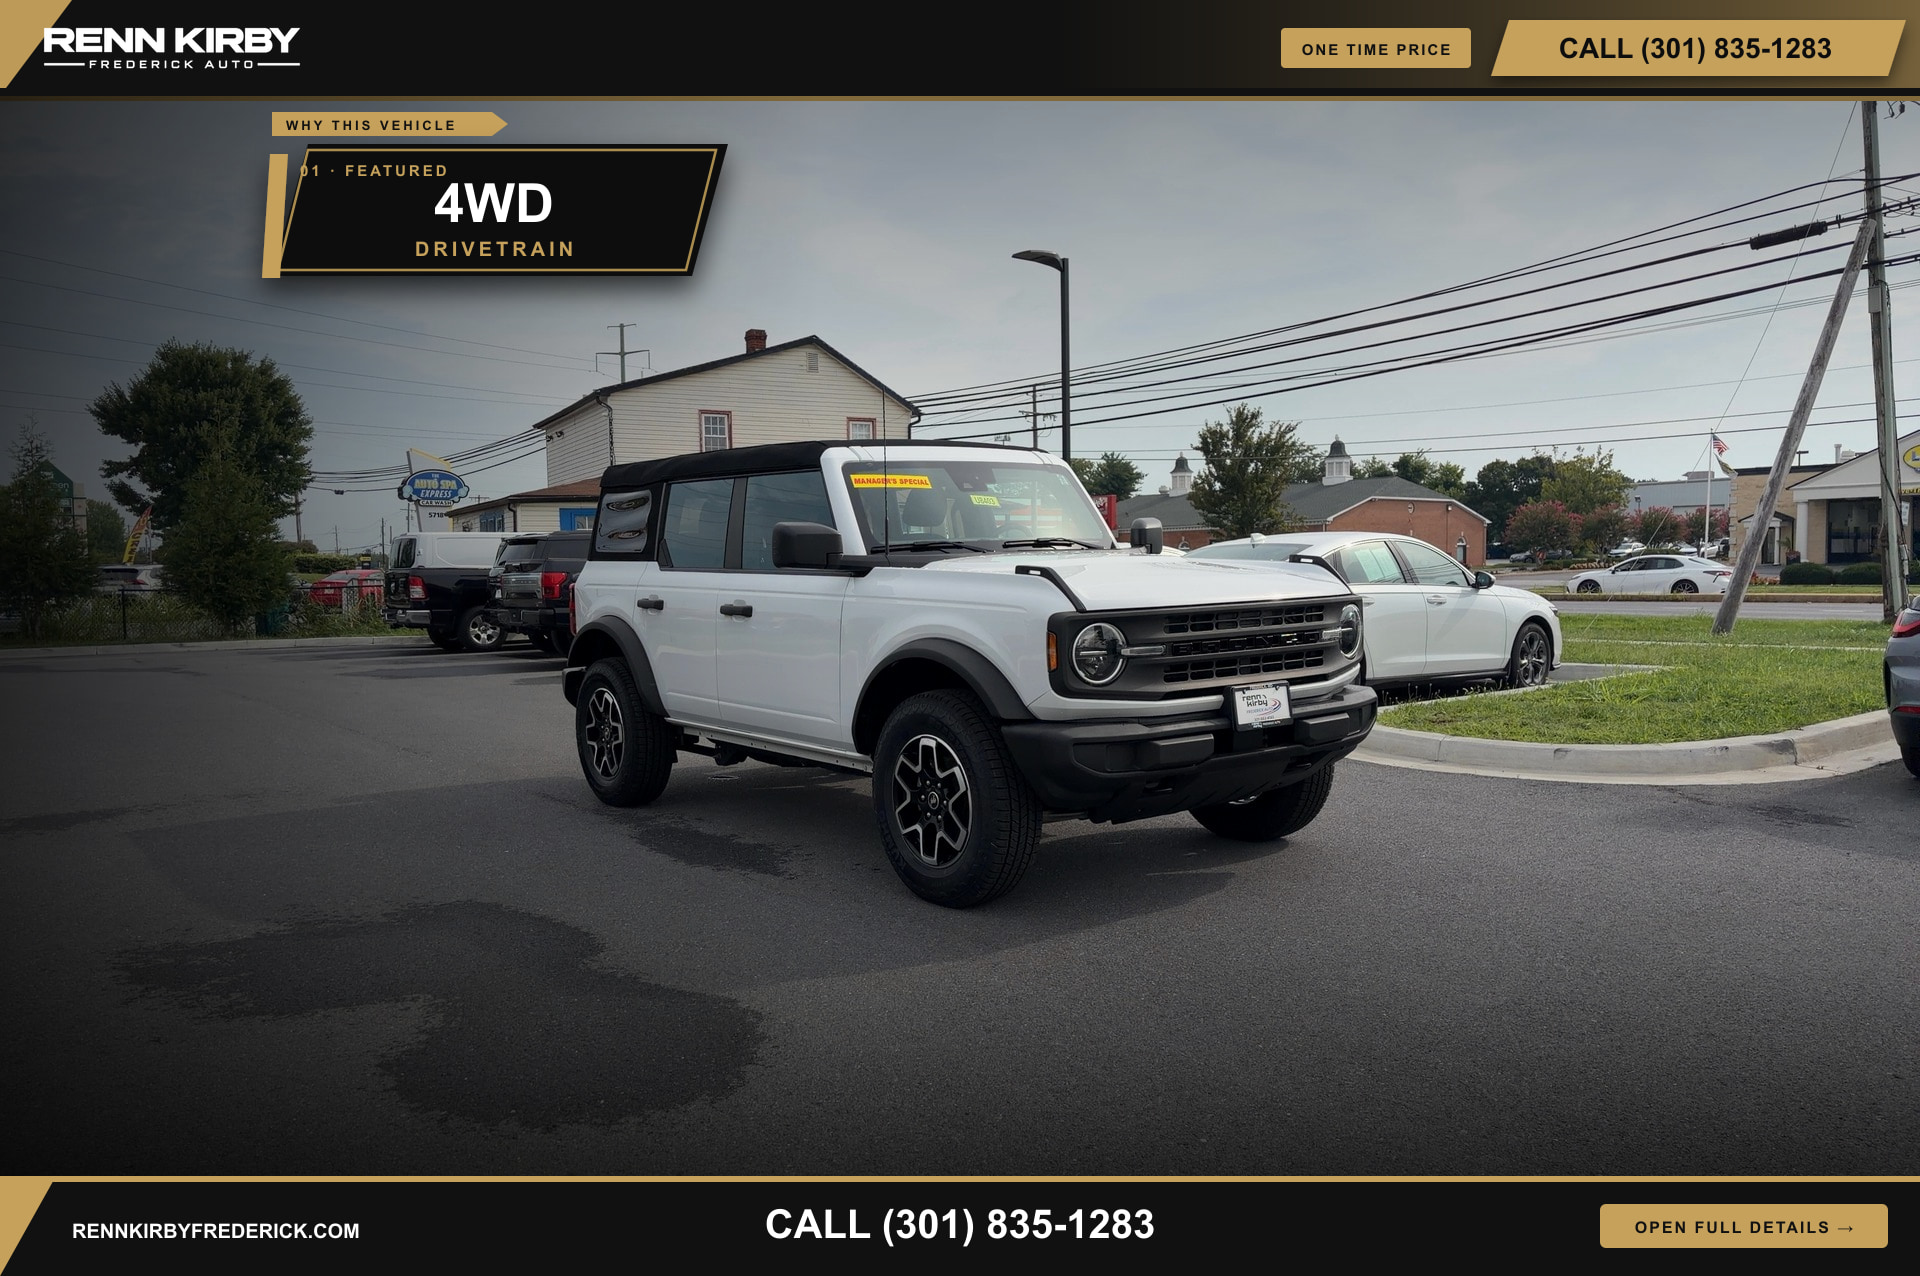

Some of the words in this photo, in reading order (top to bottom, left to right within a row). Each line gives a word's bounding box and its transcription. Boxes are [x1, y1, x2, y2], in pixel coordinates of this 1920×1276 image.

[414, 478, 439, 489] AUTO
[440, 479, 458, 489] SPA
[853, 477, 898, 485] MANAGER'S
[899, 478, 929, 486] SPECIAL
[421, 490, 452, 498] EXPRESS
[1242, 694, 1261, 702] renn
